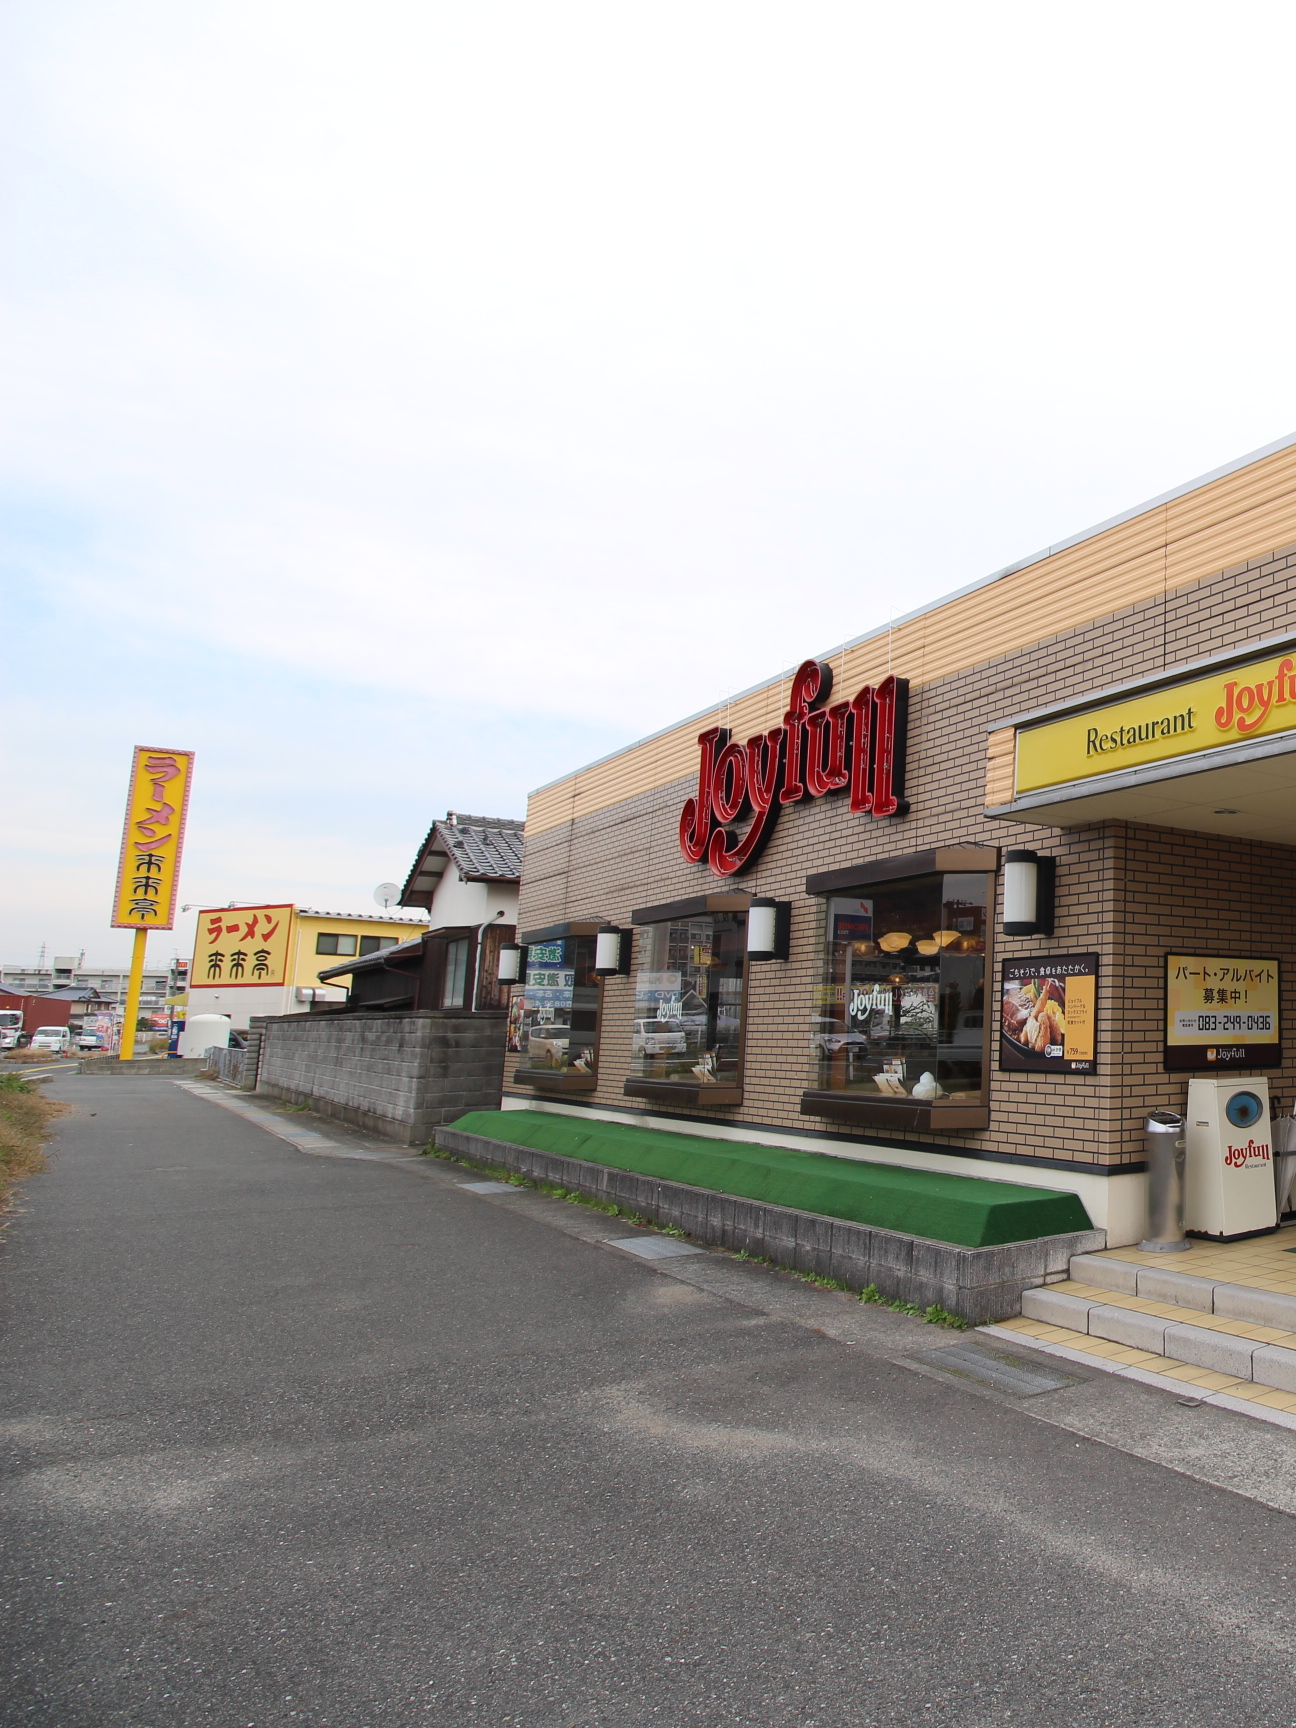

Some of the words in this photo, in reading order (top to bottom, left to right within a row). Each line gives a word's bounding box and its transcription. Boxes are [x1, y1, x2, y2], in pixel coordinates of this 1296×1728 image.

[1086, 707, 1195, 755] Restaurant
[679, 659, 910, 878] Joyfull
[134, 755, 182, 852] ラーメン
[207, 913, 280, 945] ラーメン
[1009, 963, 1089, 978] ごちそうで、食卓をあたたかく。
[1175, 966, 1274, 984] パート・アルバイト
[850, 984, 893, 1020] Joyfull
[1198, 1015, 1271, 1031] 083-249-0436
[1217, 1047, 1245, 1060] Joyfull
[1225, 1139, 1270, 1168] Joyfull
